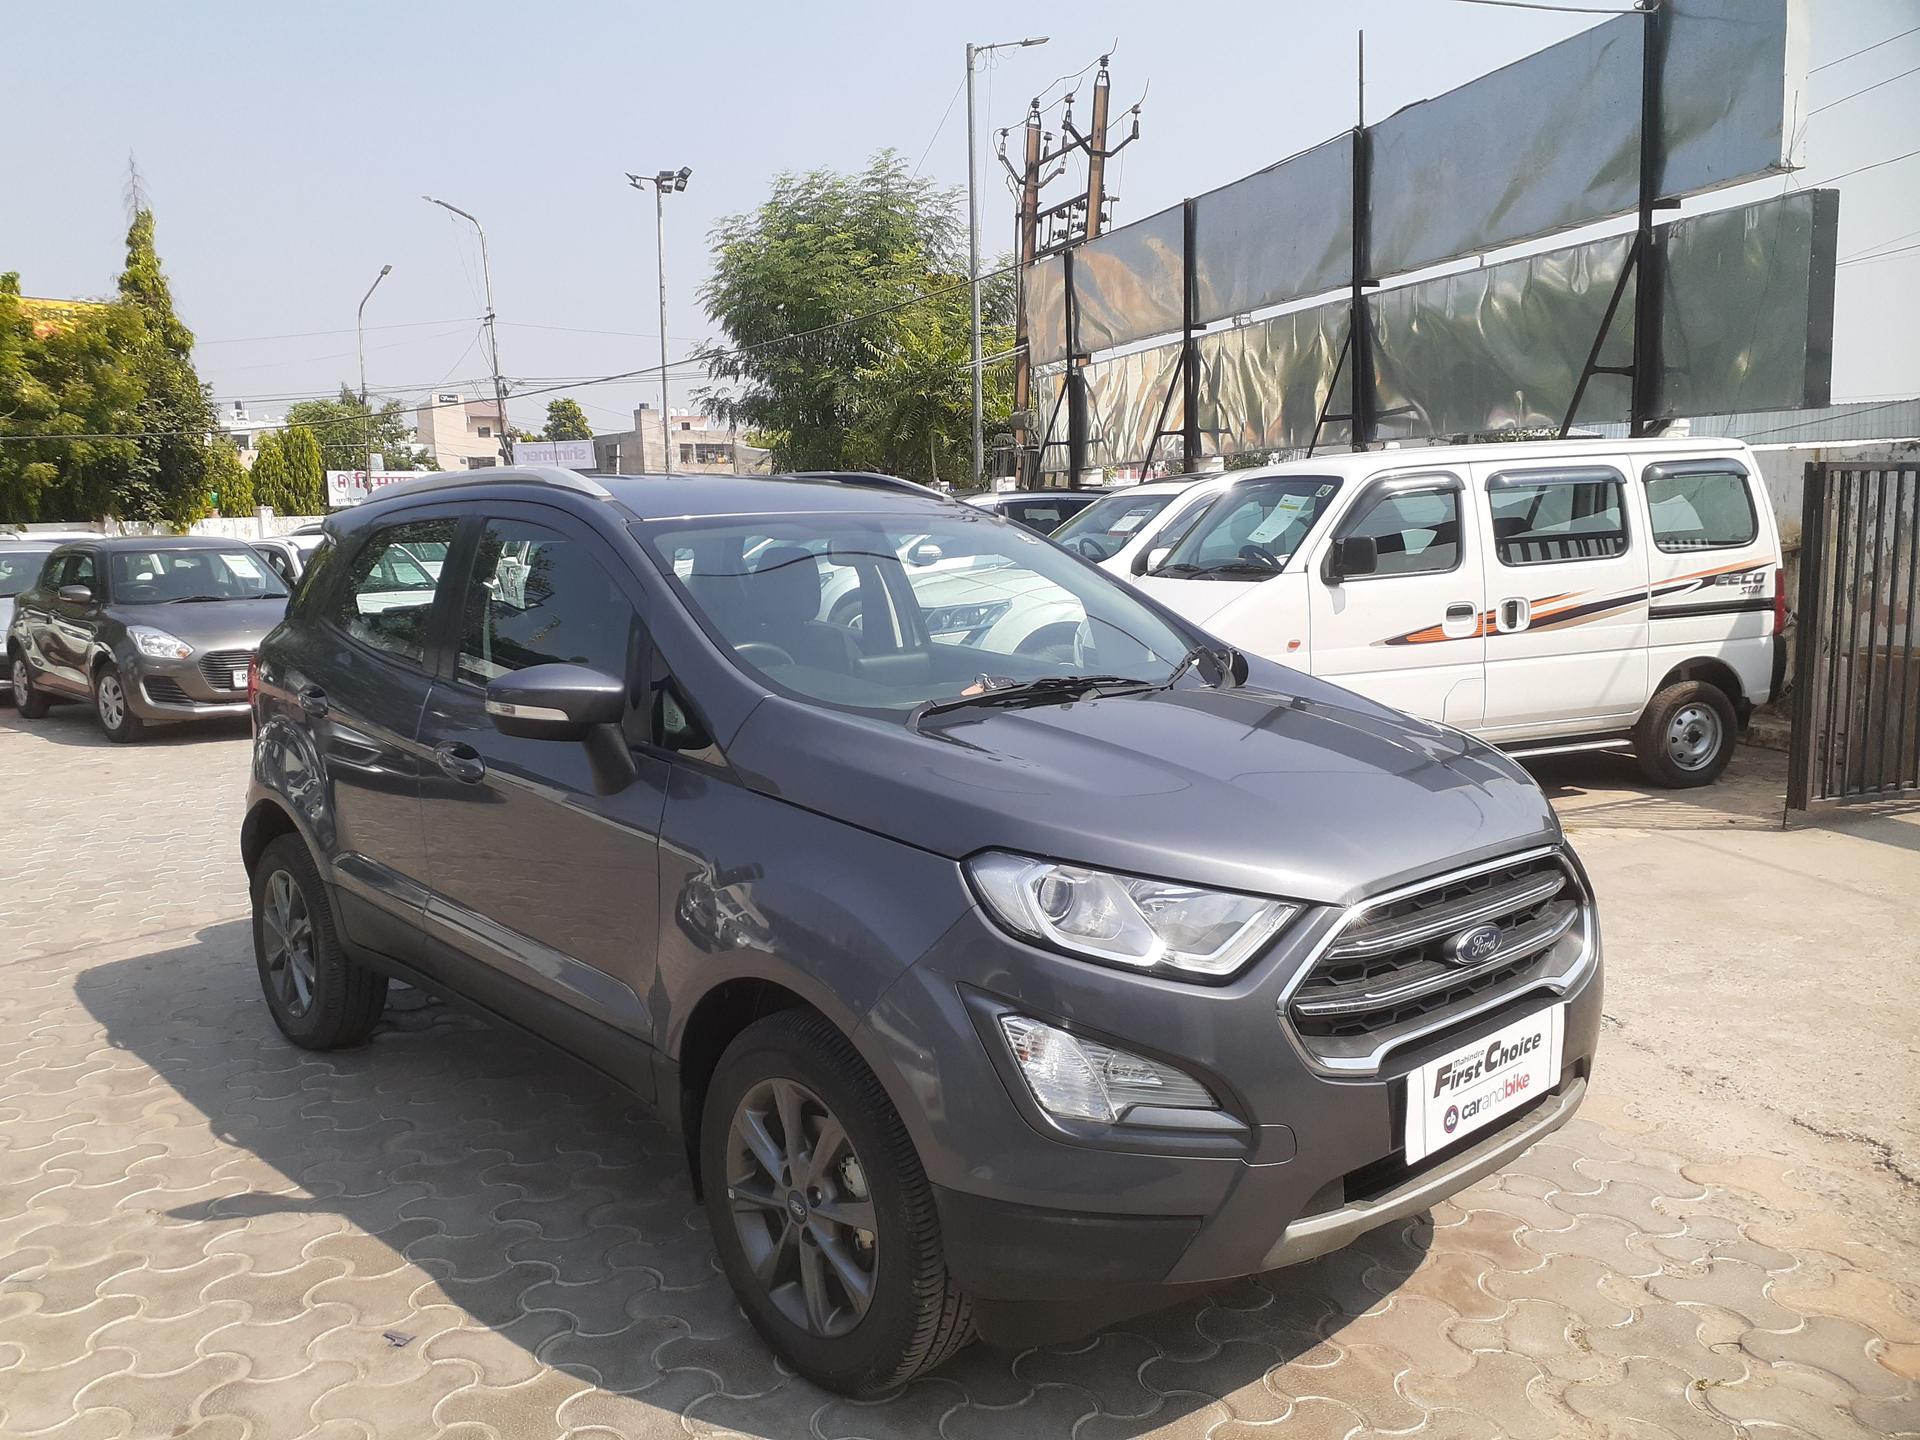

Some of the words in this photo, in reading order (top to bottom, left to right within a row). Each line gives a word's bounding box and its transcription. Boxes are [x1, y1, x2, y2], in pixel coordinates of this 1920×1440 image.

[1715, 572, 1766, 586] EECO
[1471, 933, 1496, 956] Ford
[1433, 1059, 1483, 1099] First
[1484, 1033, 1541, 1073] Choice
